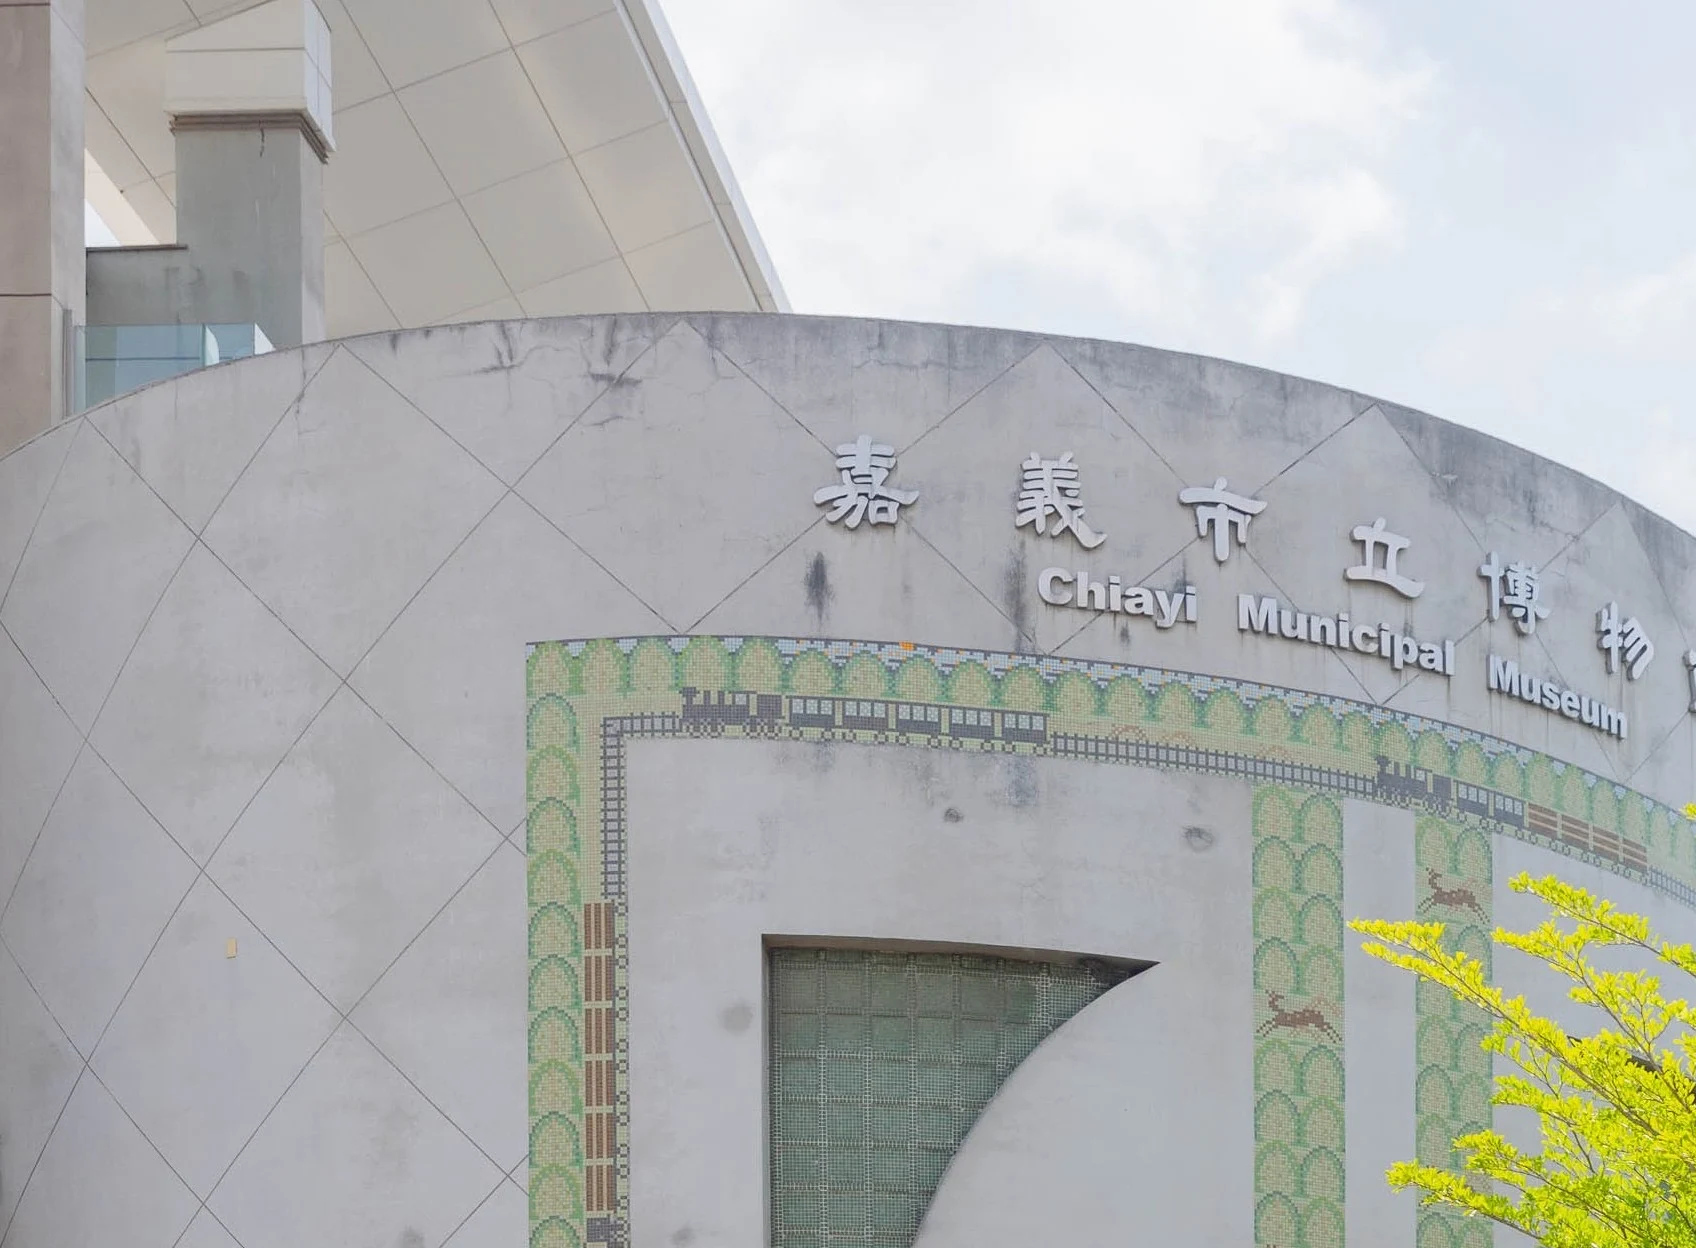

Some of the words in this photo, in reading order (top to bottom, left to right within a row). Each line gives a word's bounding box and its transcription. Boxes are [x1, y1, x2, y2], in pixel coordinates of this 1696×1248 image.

[1037, 568, 1198, 628] Chiayi
[1237, 594, 1454, 676] Municipal
[1488, 656, 1628, 739] Museum
